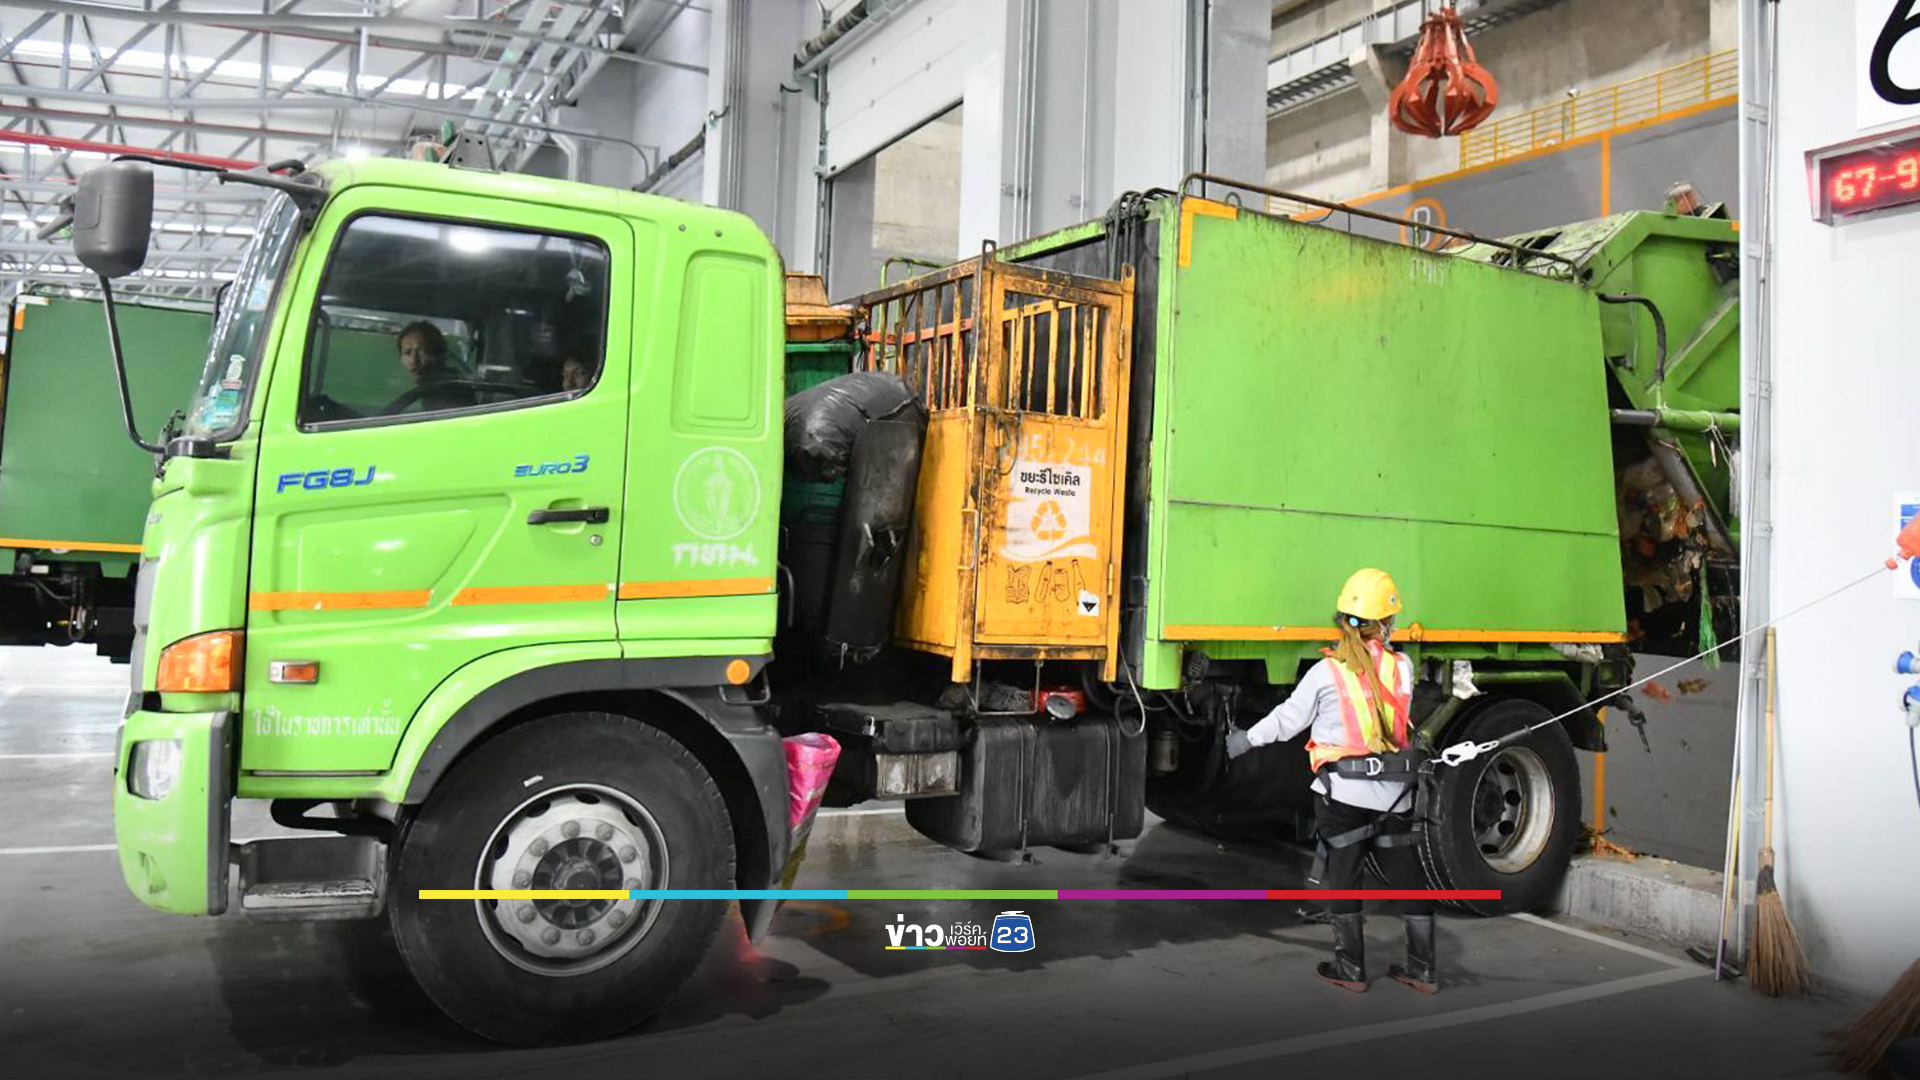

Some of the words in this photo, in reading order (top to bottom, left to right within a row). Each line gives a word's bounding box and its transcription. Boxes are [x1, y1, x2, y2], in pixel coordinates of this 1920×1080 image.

[276, 466, 376, 493] FG8J
[1025, 486, 1051, 496] Recycle
[1054, 488, 1076, 497] Waste
